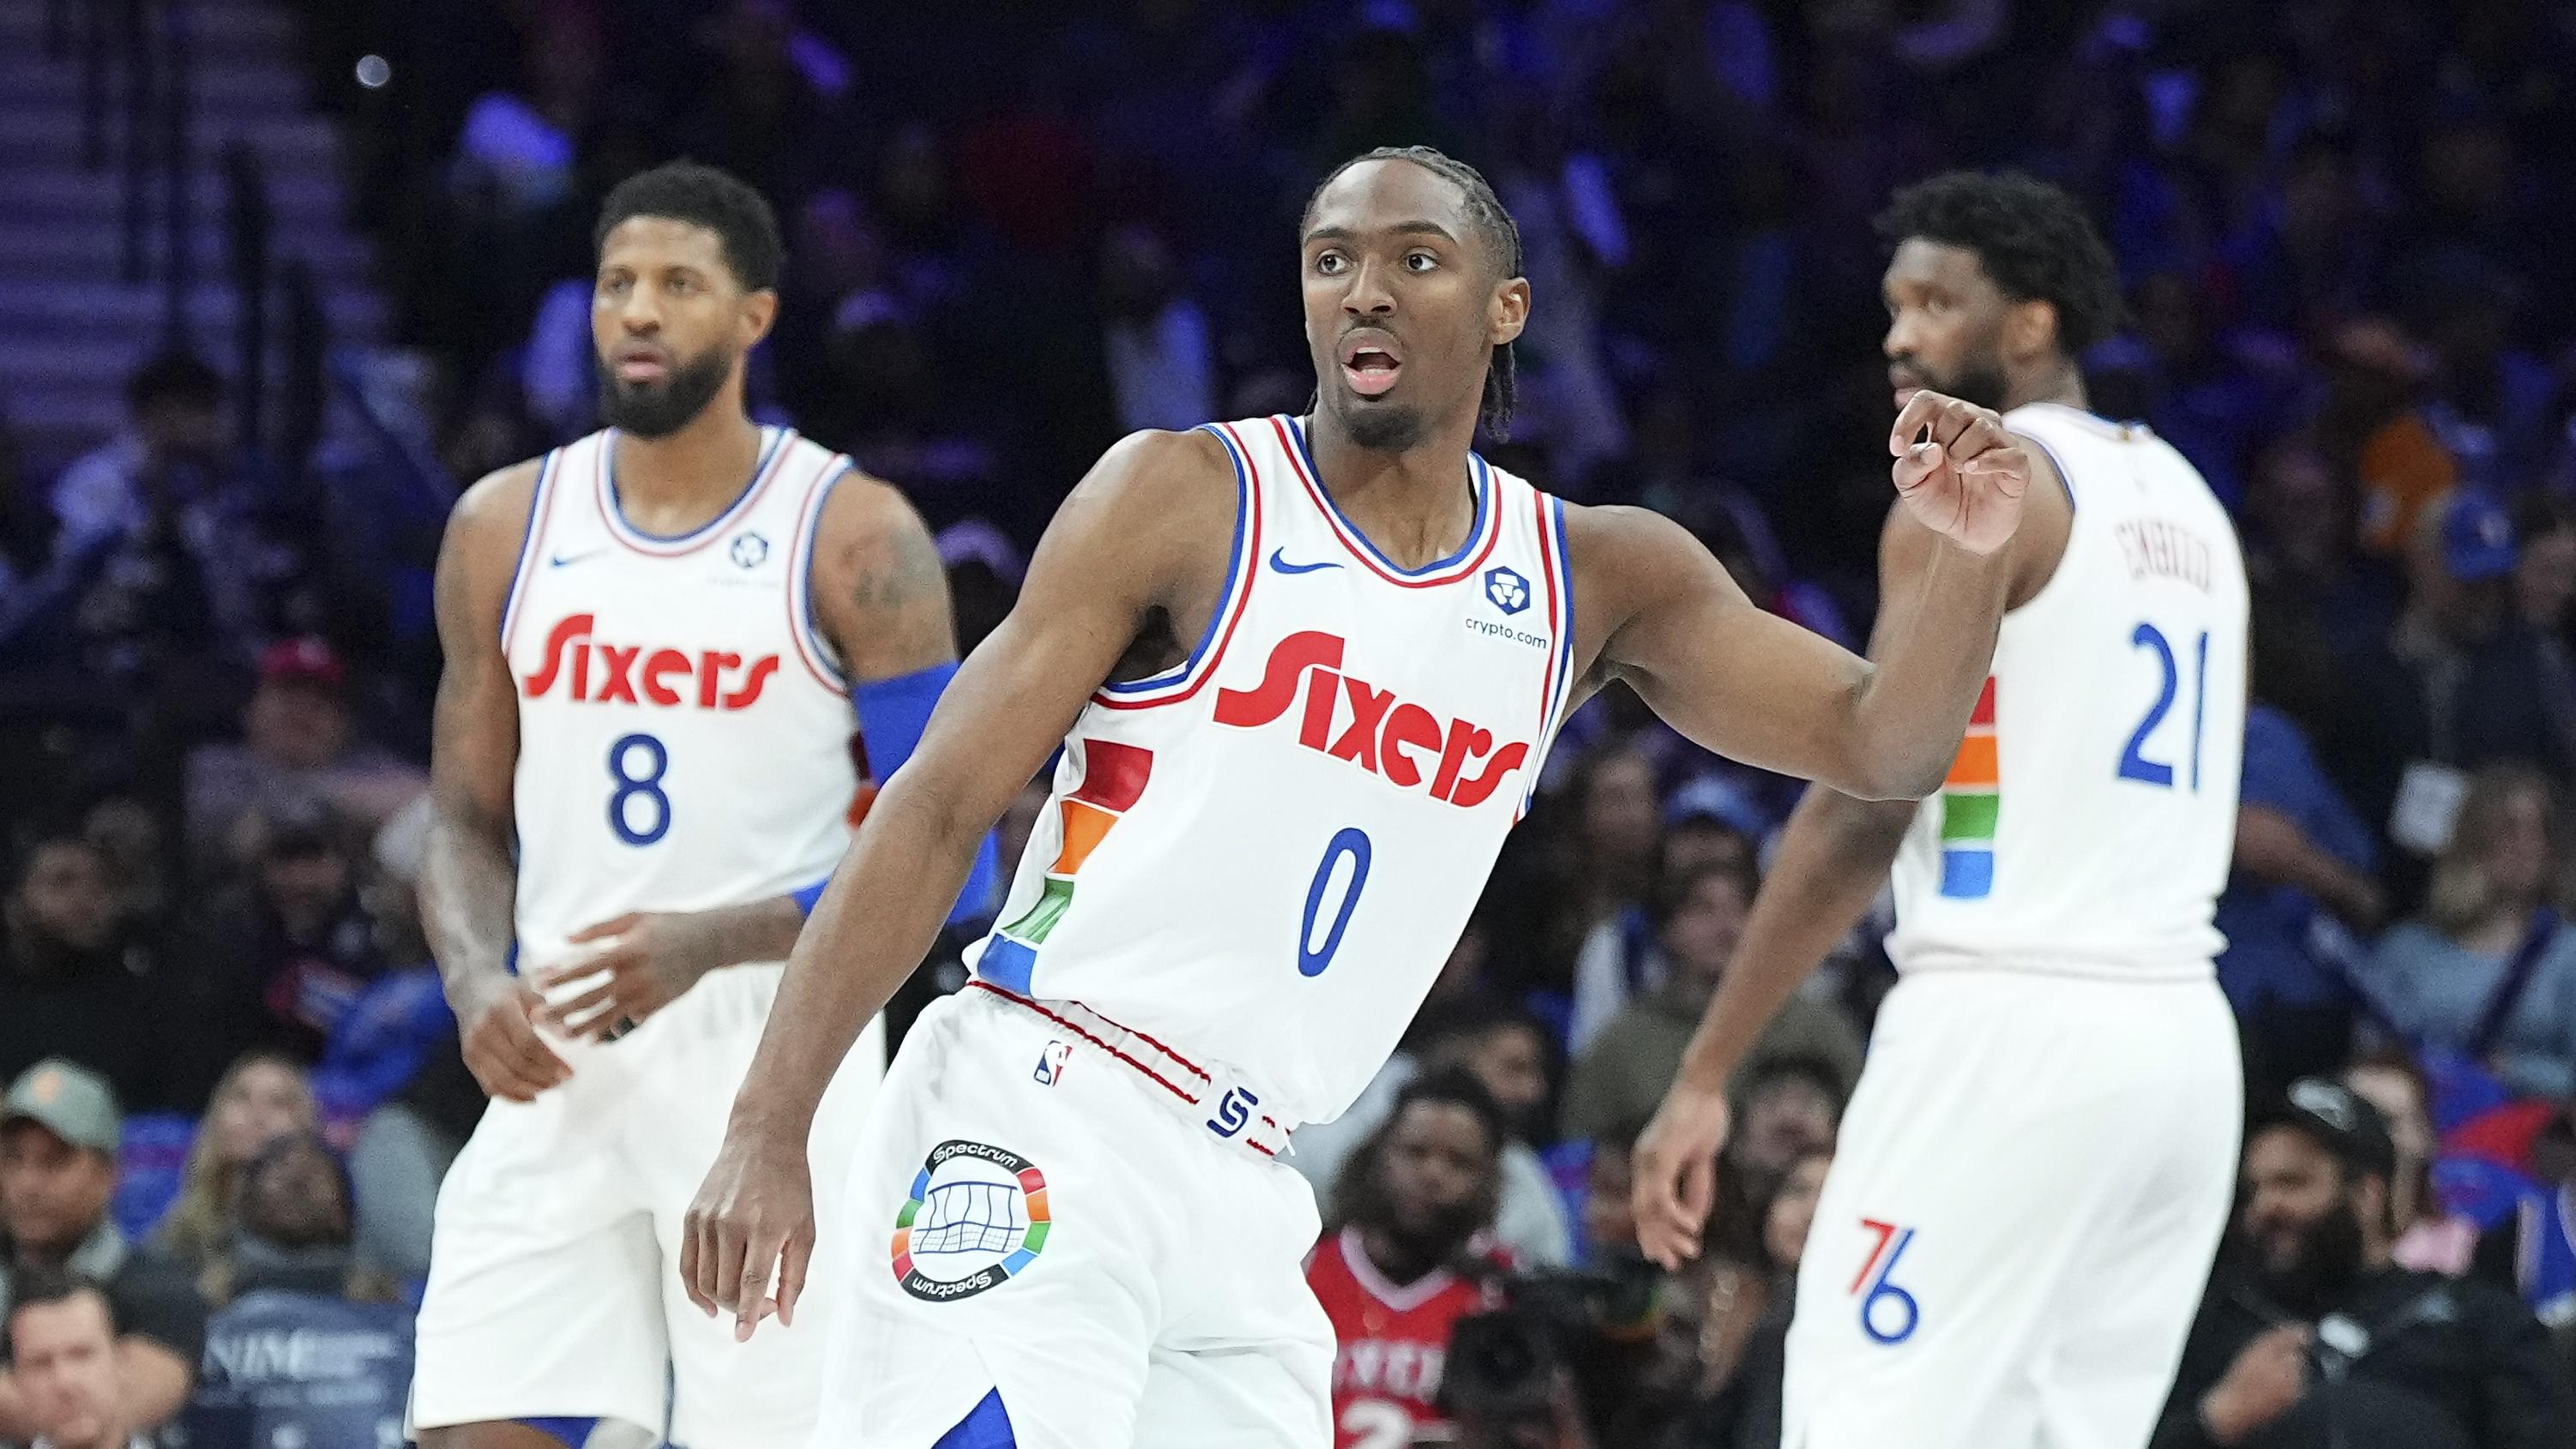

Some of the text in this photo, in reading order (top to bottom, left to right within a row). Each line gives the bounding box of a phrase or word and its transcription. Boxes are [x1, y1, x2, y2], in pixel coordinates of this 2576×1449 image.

[524, 613, 779, 710] Sixers
[1465, 617, 1548, 650] crypto.com
[1213, 630, 1530, 808] Sixers
[2118, 622, 2209, 791] 21
[610, 733, 671, 846] 8
[1297, 827, 1372, 977] 0
[932, 1143, 1019, 1169] Spectrum
[912, 1271, 992, 1299] Spectrum
[1850, 1218, 1919, 1345] 76
